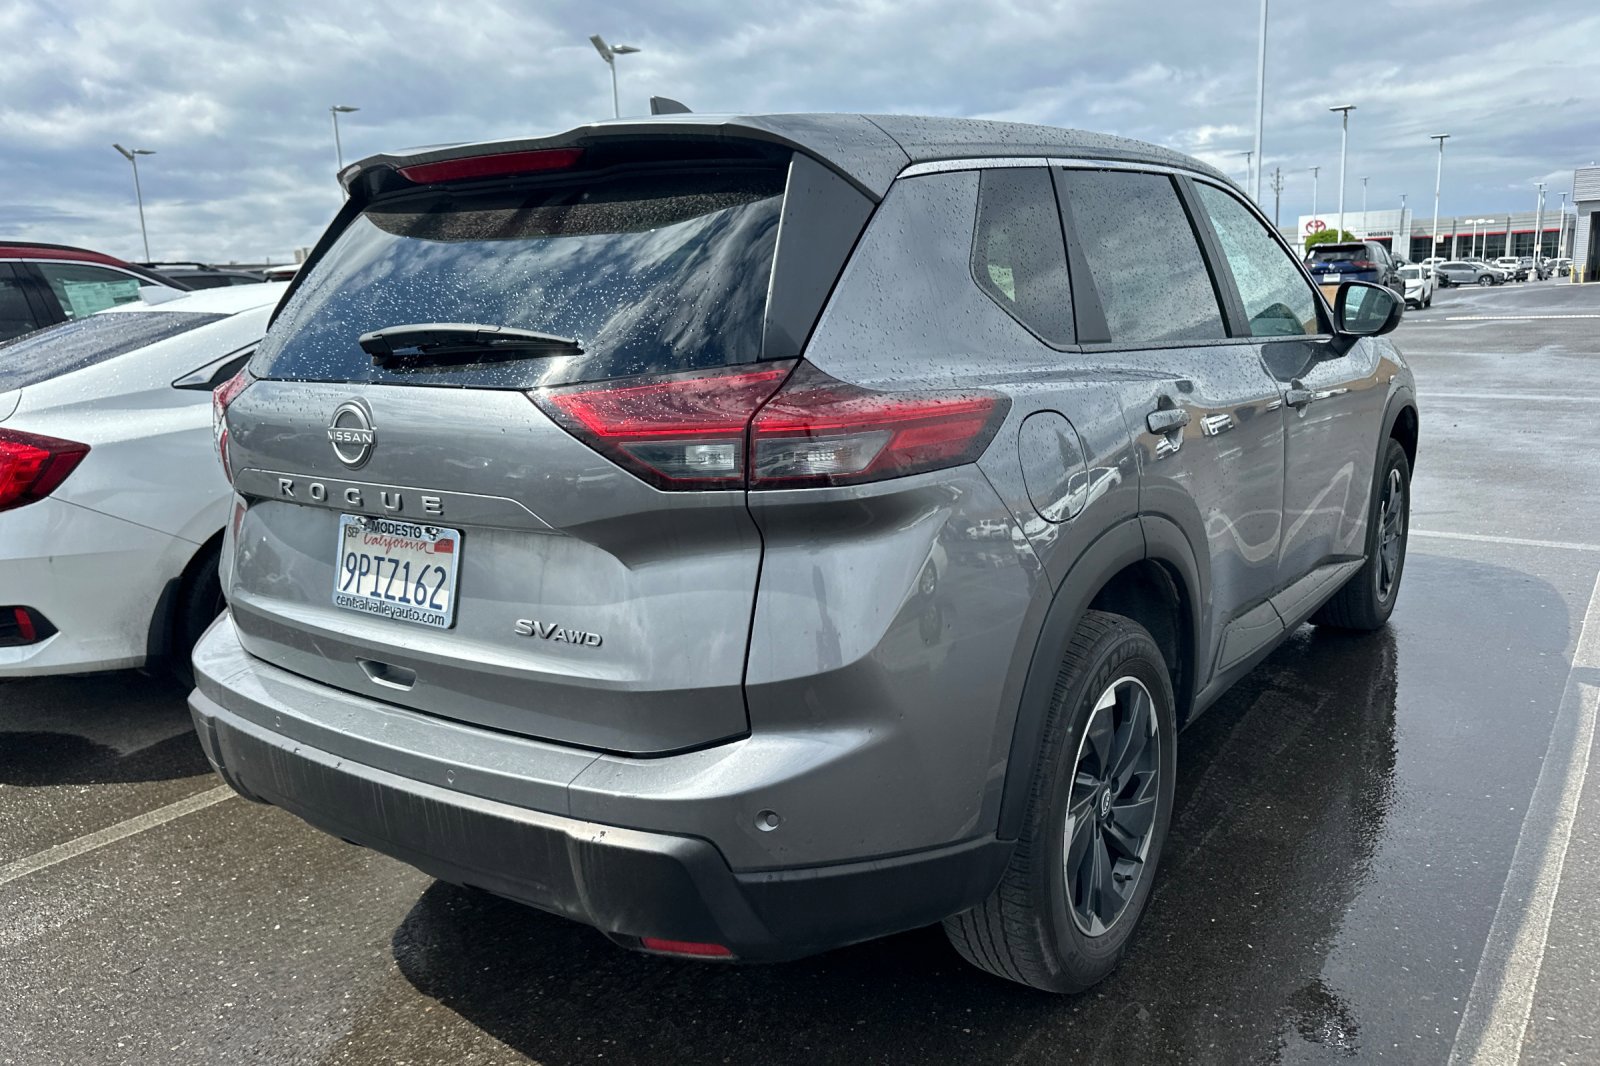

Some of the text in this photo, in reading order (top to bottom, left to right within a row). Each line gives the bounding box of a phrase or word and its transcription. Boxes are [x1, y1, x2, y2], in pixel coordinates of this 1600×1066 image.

[327, 430, 372, 443] NISSAN
[278, 478, 443, 515] ROGUE
[347, 526, 360, 538] SEP
[371, 520, 422, 538] MODESTO
[363, 532, 435, 554] California
[343, 552, 446, 610] 9PIZ162
[336, 595, 445, 626] centralvalleyauto.com
[514, 619, 603, 647] SV AWD
